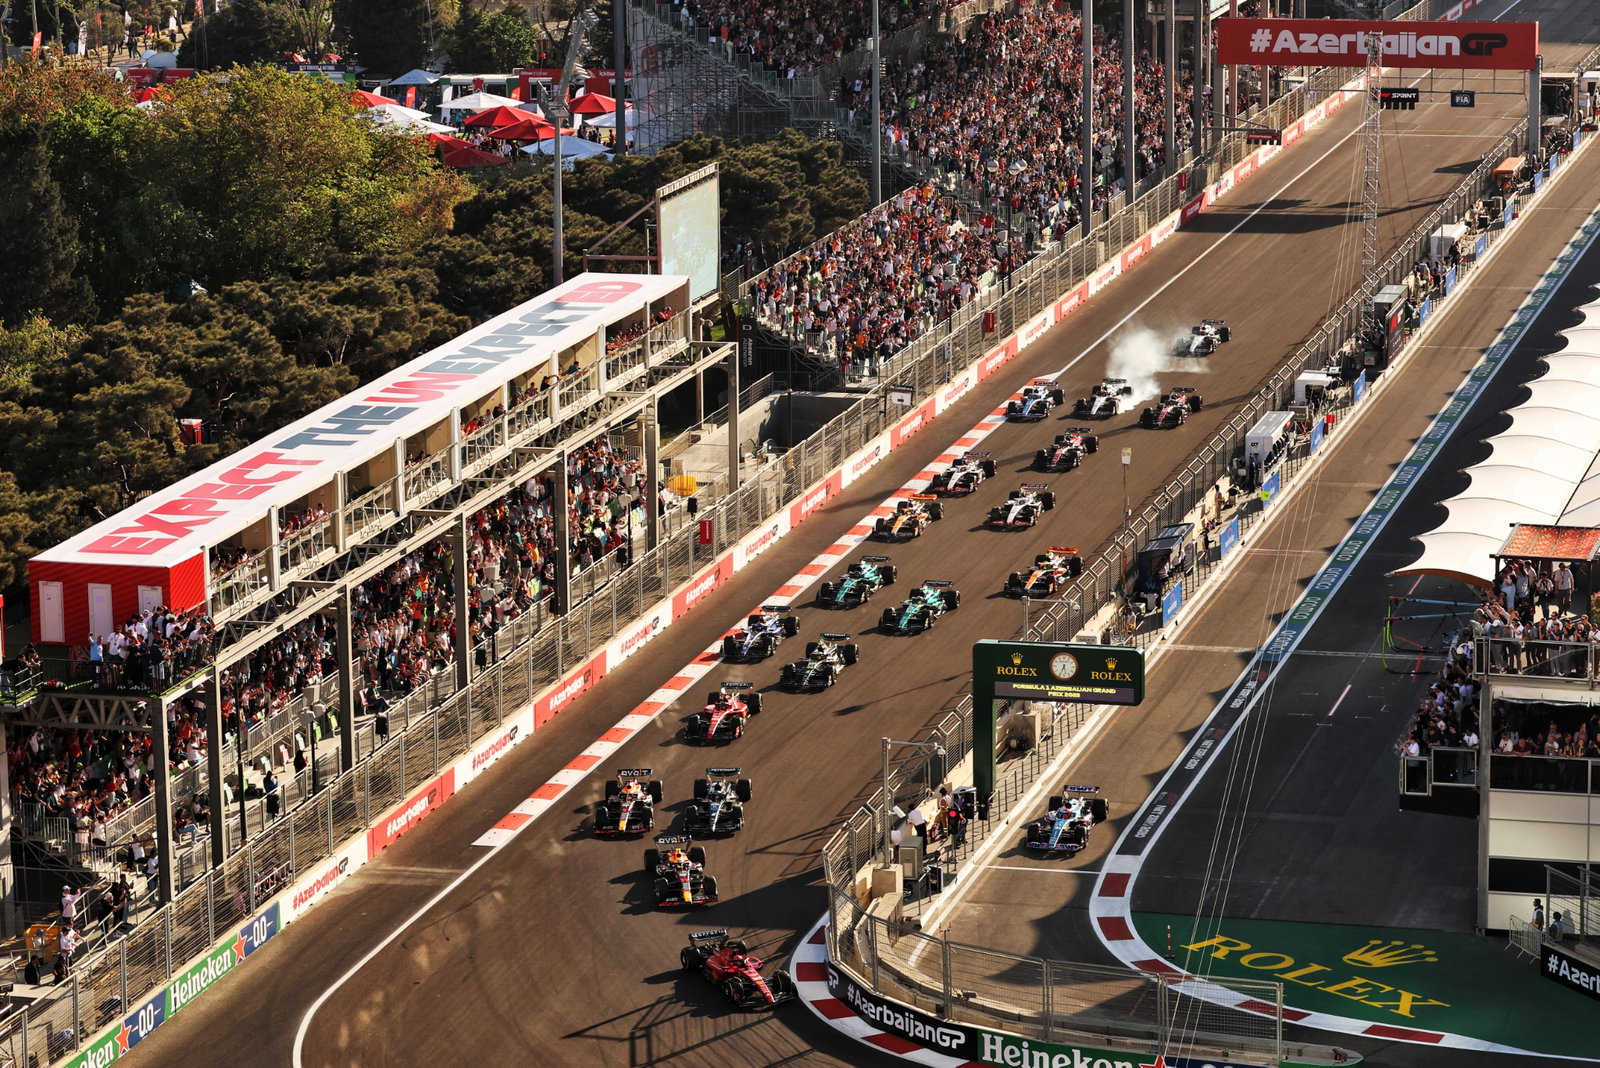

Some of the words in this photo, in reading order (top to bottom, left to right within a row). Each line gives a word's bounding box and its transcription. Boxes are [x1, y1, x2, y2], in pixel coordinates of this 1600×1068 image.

[1456, 95, 1470, 103] FIA
[77, 451, 324, 555] EXPECT
[277, 405, 420, 450] THE
[364, 281, 644, 404] UNEXPECTED
[997, 666, 1038, 677] ROLEX
[1091, 671, 1132, 682] ROLEX
[292, 856, 348, 910] #AzerbaijanGP
[169, 950, 232, 1012] Heineken
[1180, 934, 1452, 1018] ROLEX
[847, 984, 966, 1049] #AzerbaijanGP
